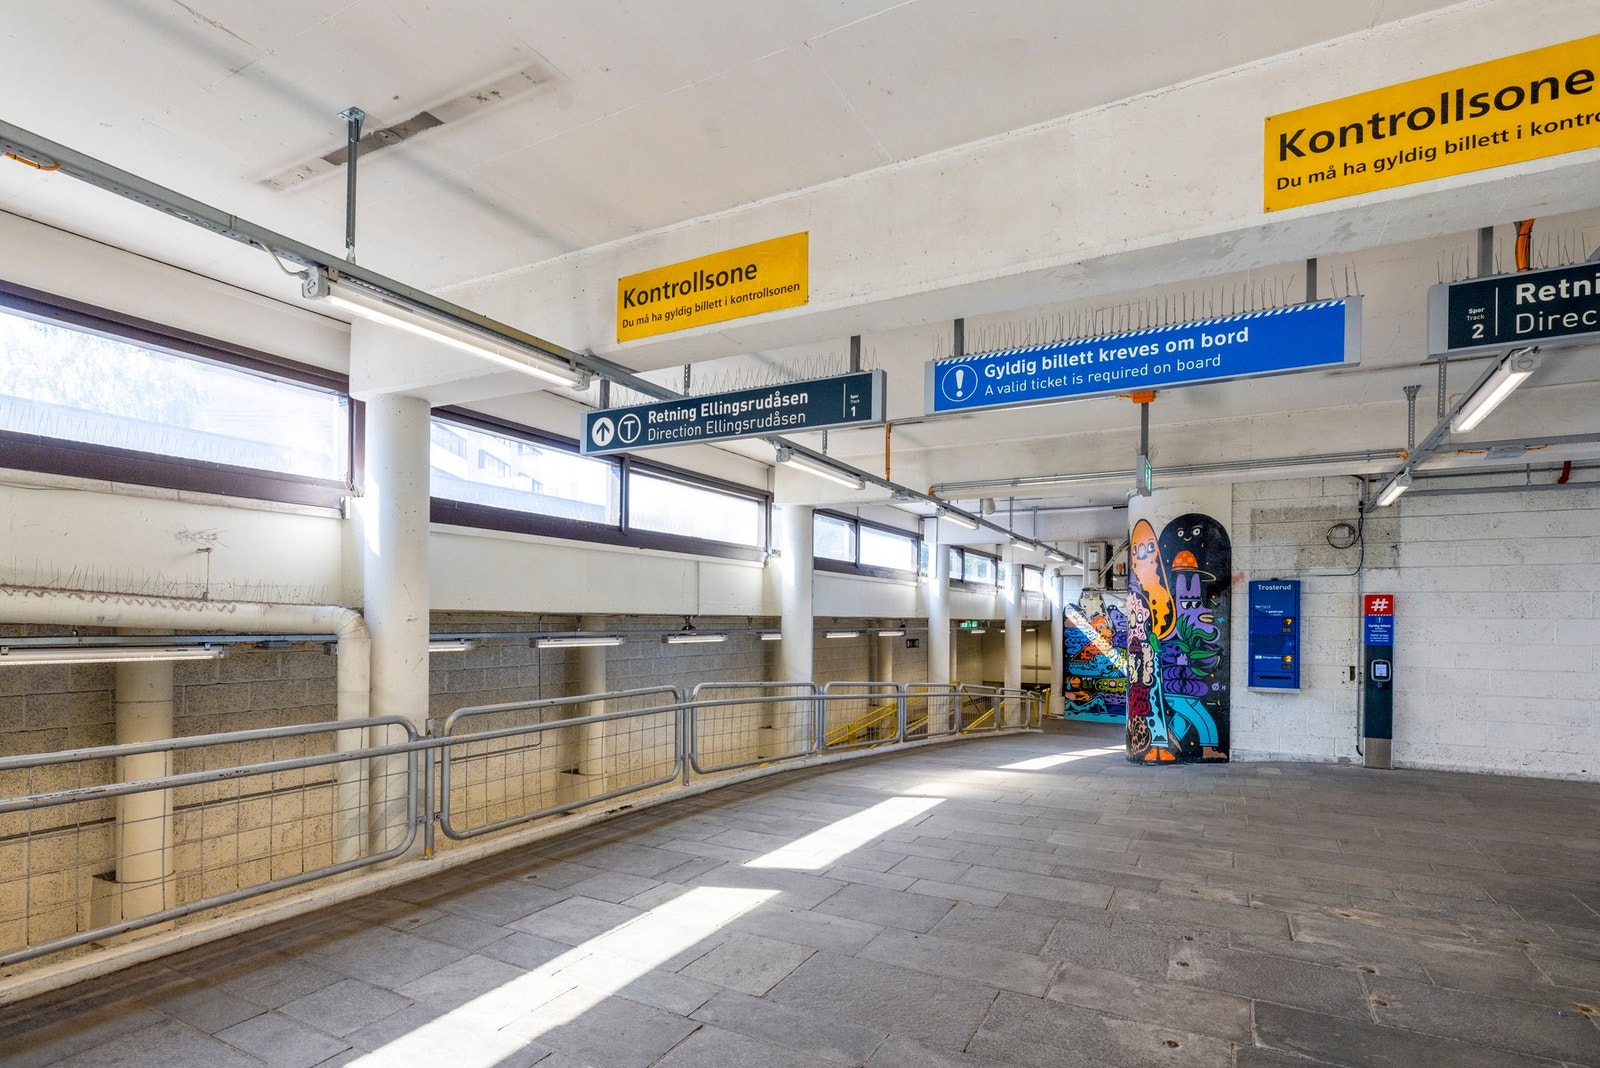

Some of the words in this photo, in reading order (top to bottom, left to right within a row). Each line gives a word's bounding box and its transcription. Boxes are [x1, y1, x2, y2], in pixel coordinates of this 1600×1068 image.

[1279, 68, 1595, 162] Kontrollsone
[1276, 176, 1302, 191] Du
[1308, 165, 1337, 184] må
[1343, 162, 1367, 176] ha
[1373, 145, 1437, 173] gyldig
[1445, 129, 1509, 155] billett
[1517, 125, 1522, 140] i
[623, 263, 758, 309] Kontrollsone
[622, 319, 634, 329] Du
[636, 315, 650, 326] må
[651, 312, 662, 322] ha
[664, 305, 692, 322] gyldig
[695, 299, 722, 313] billett
[730, 283, 800, 305] kontrollsonen
[1468, 307, 1485, 315] Spor
[1516, 309, 1598, 334] Direc
[1471, 323, 1484, 339] 2
[984, 359, 1037, 380] Gyldig
[1041, 350, 1094, 371] billett
[1099, 342, 1159, 363] kreves
[1165, 338, 1195, 353] om
[1201, 326, 1249, 349] bord
[984, 384, 994, 396] A
[997, 379, 1027, 394] valid
[1031, 375, 1068, 390] ticket
[1072, 372, 1084, 385] is
[1088, 364, 1148, 383] required
[1153, 362, 1171, 375] on
[1176, 354, 1221, 372] board
[648, 406, 697, 424] Retning
[701, 390, 808, 417] Ellingsrudåsen
[648, 424, 701, 441] Direction
[706, 410, 806, 434] Ellingsrudåsen
[850, 406, 856, 417] 1
